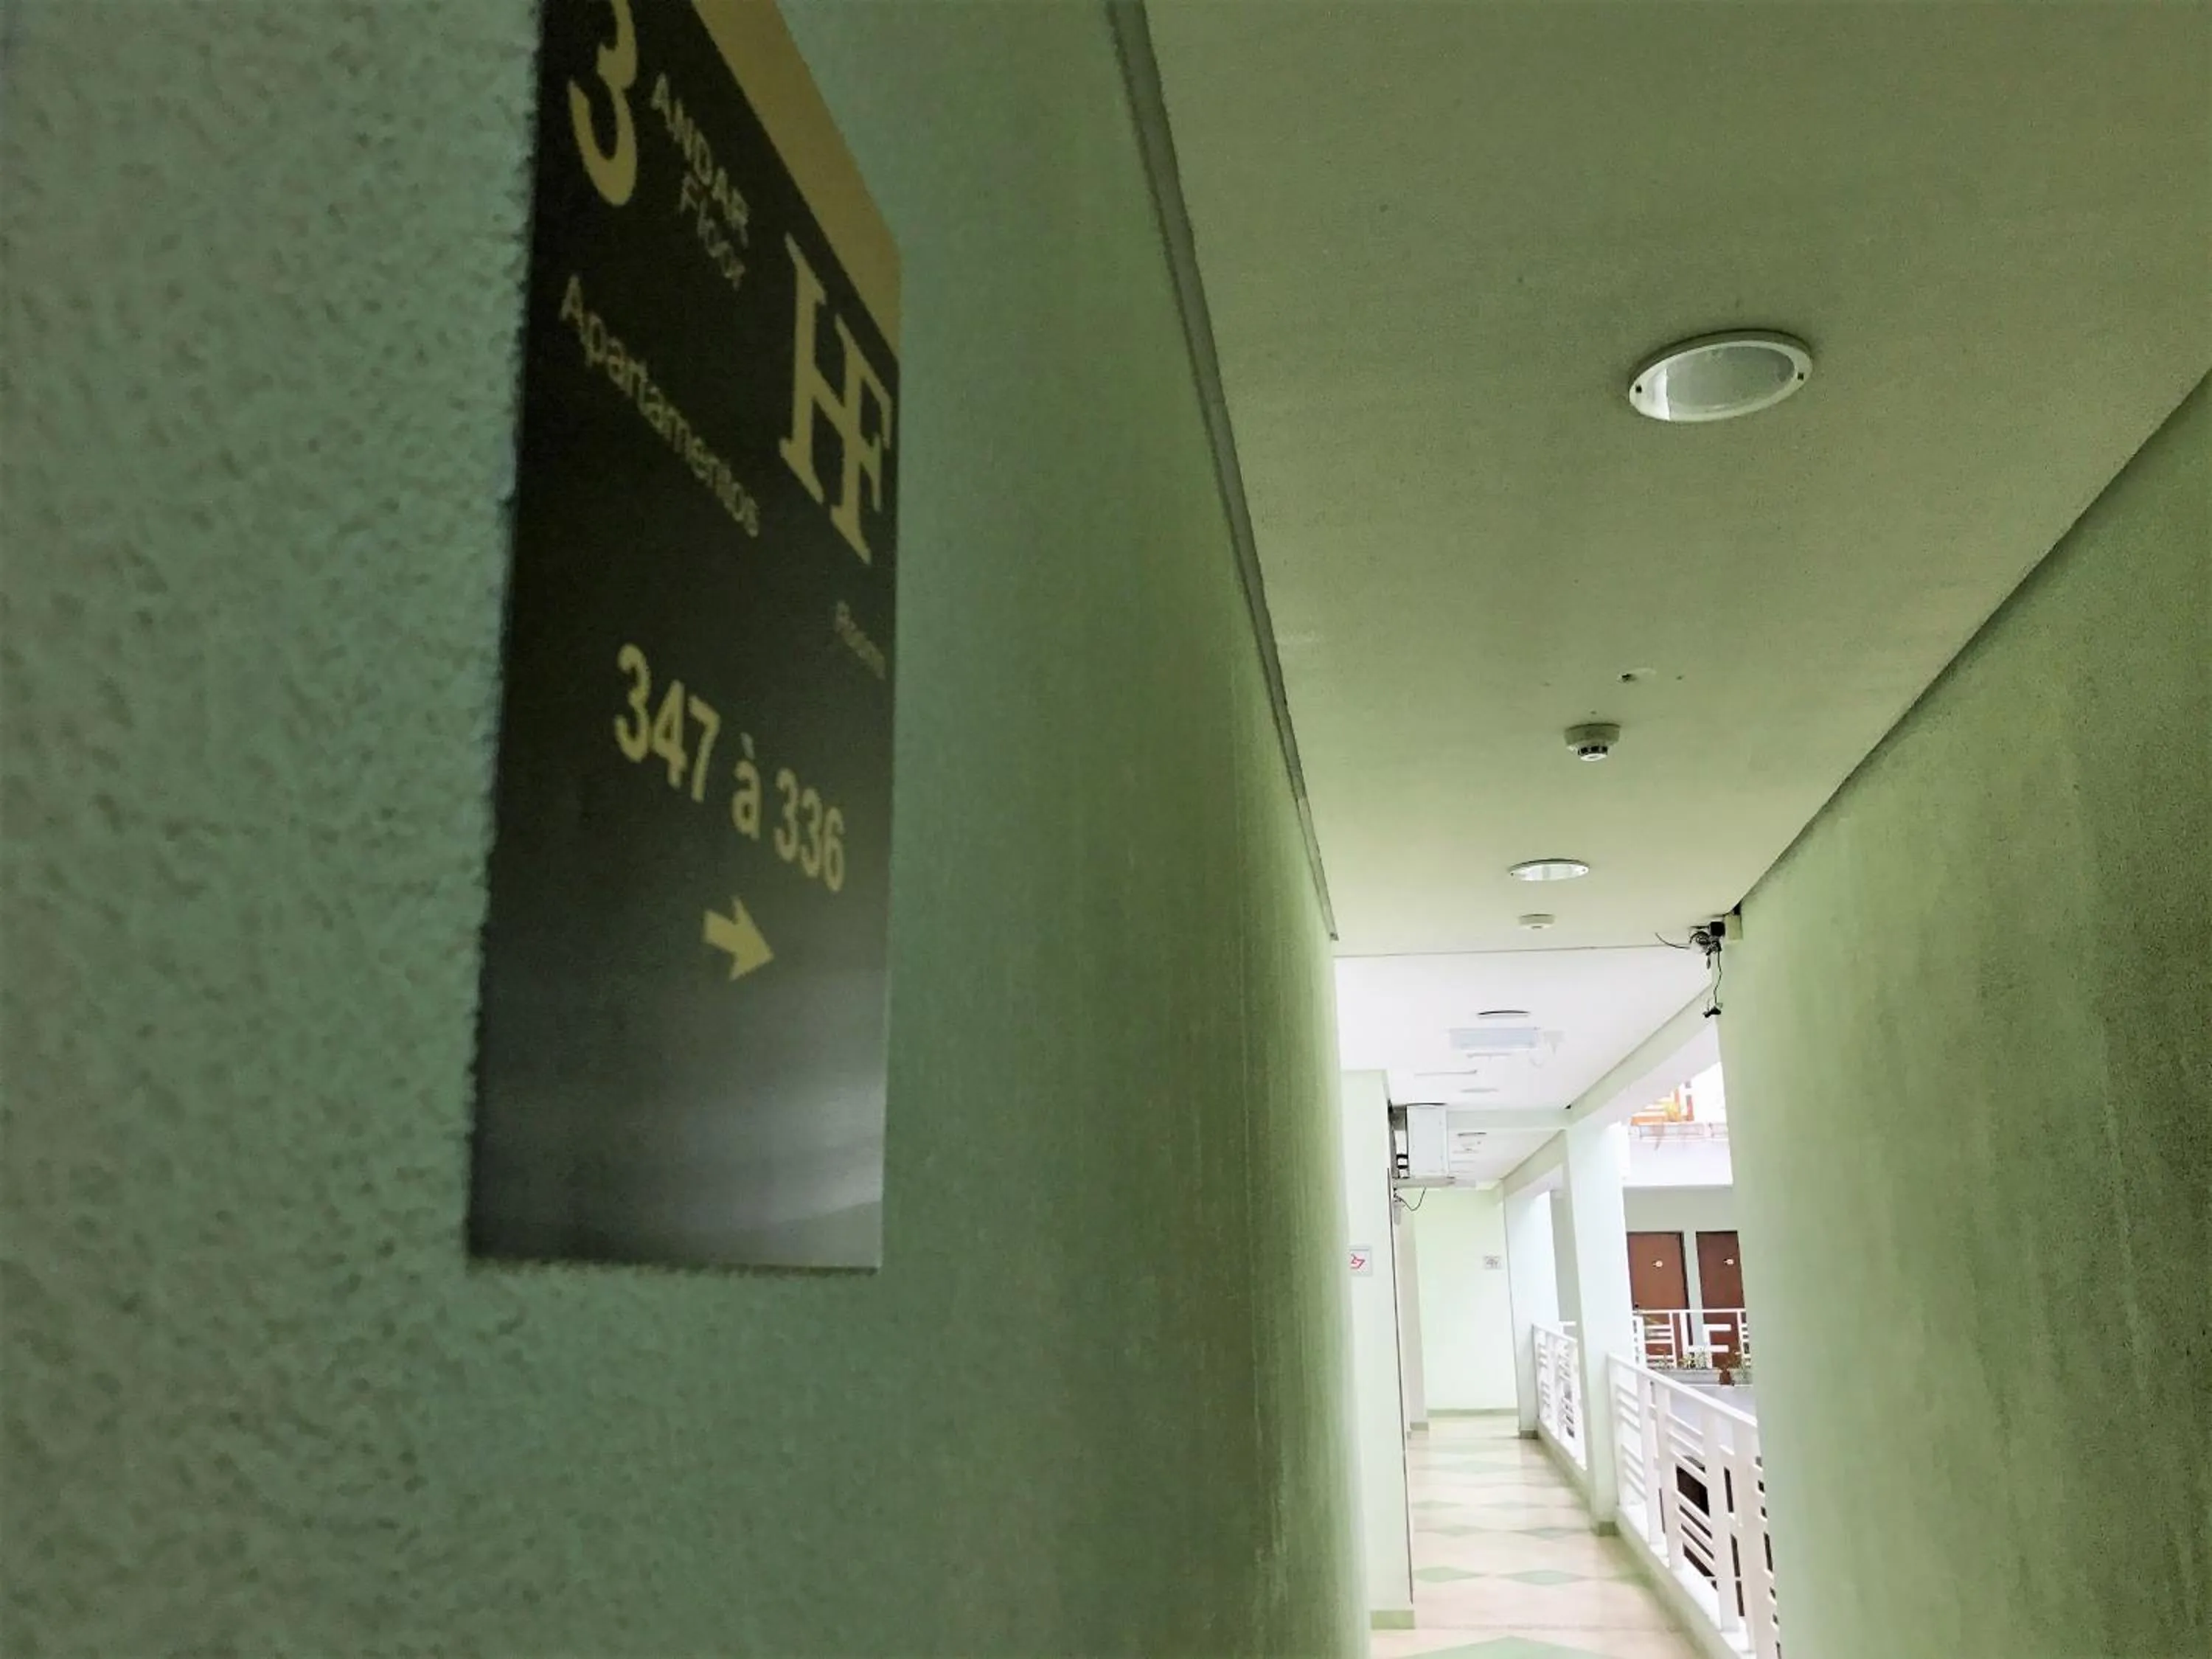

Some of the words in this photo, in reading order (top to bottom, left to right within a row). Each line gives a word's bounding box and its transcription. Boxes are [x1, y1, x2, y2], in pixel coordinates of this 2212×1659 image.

[568, 0, 638, 206] 3
[651, 72, 750, 248] ANDAR
[561, 273, 759, 537] Apartamentos
[614, 642, 720, 803] 347
[732, 731, 762, 841] à
[774, 767, 845, 893] 336
